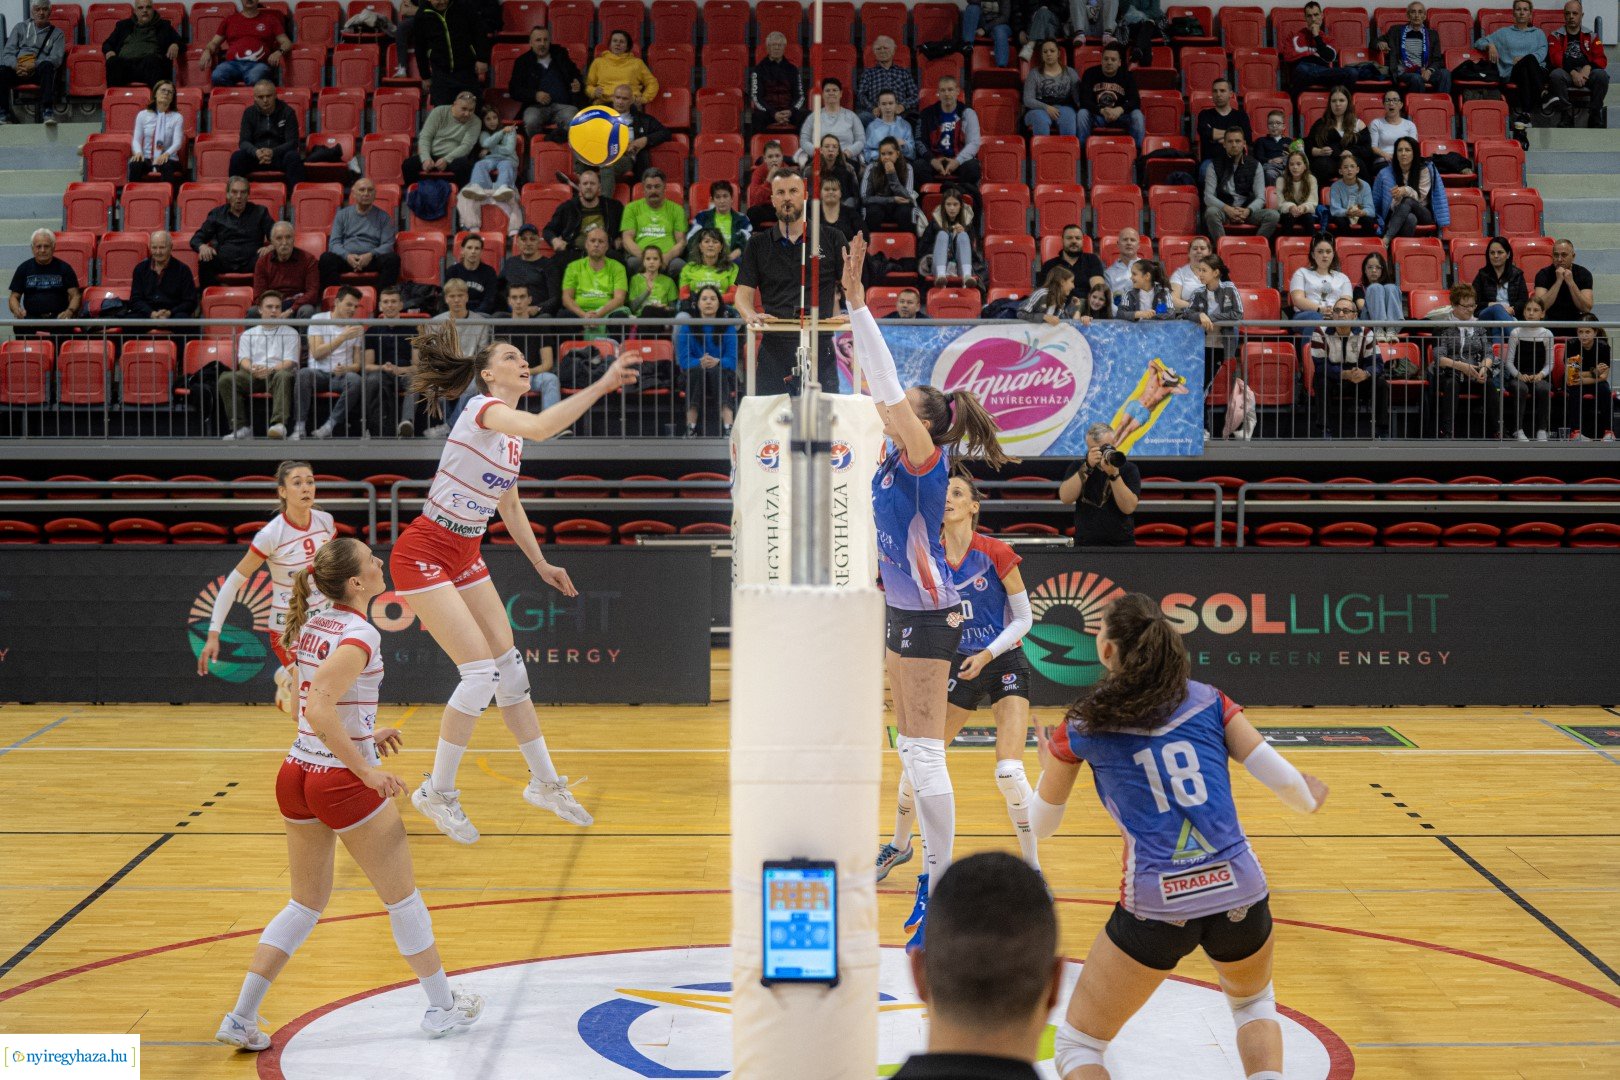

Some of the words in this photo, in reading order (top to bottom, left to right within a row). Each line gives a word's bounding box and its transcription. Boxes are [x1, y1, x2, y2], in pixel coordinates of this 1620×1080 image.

[941, 134, 950, 149] 4
[943, 360, 1075, 408] Aquarius
[991, 395, 1070, 405] NYÍREGYHÁZA
[764, 485, 780, 580] EGYHÁZA
[303, 538, 316, 555] 9
[1160, 592, 1449, 634] SOLLIGHT
[525, 648, 620, 663] NERGY
[1227, 651, 1321, 665] GREEN
[1338, 651, 1451, 665] ENERGY
[1133, 741, 1208, 813] 18
[1163, 870, 1231, 894] STRABAG
